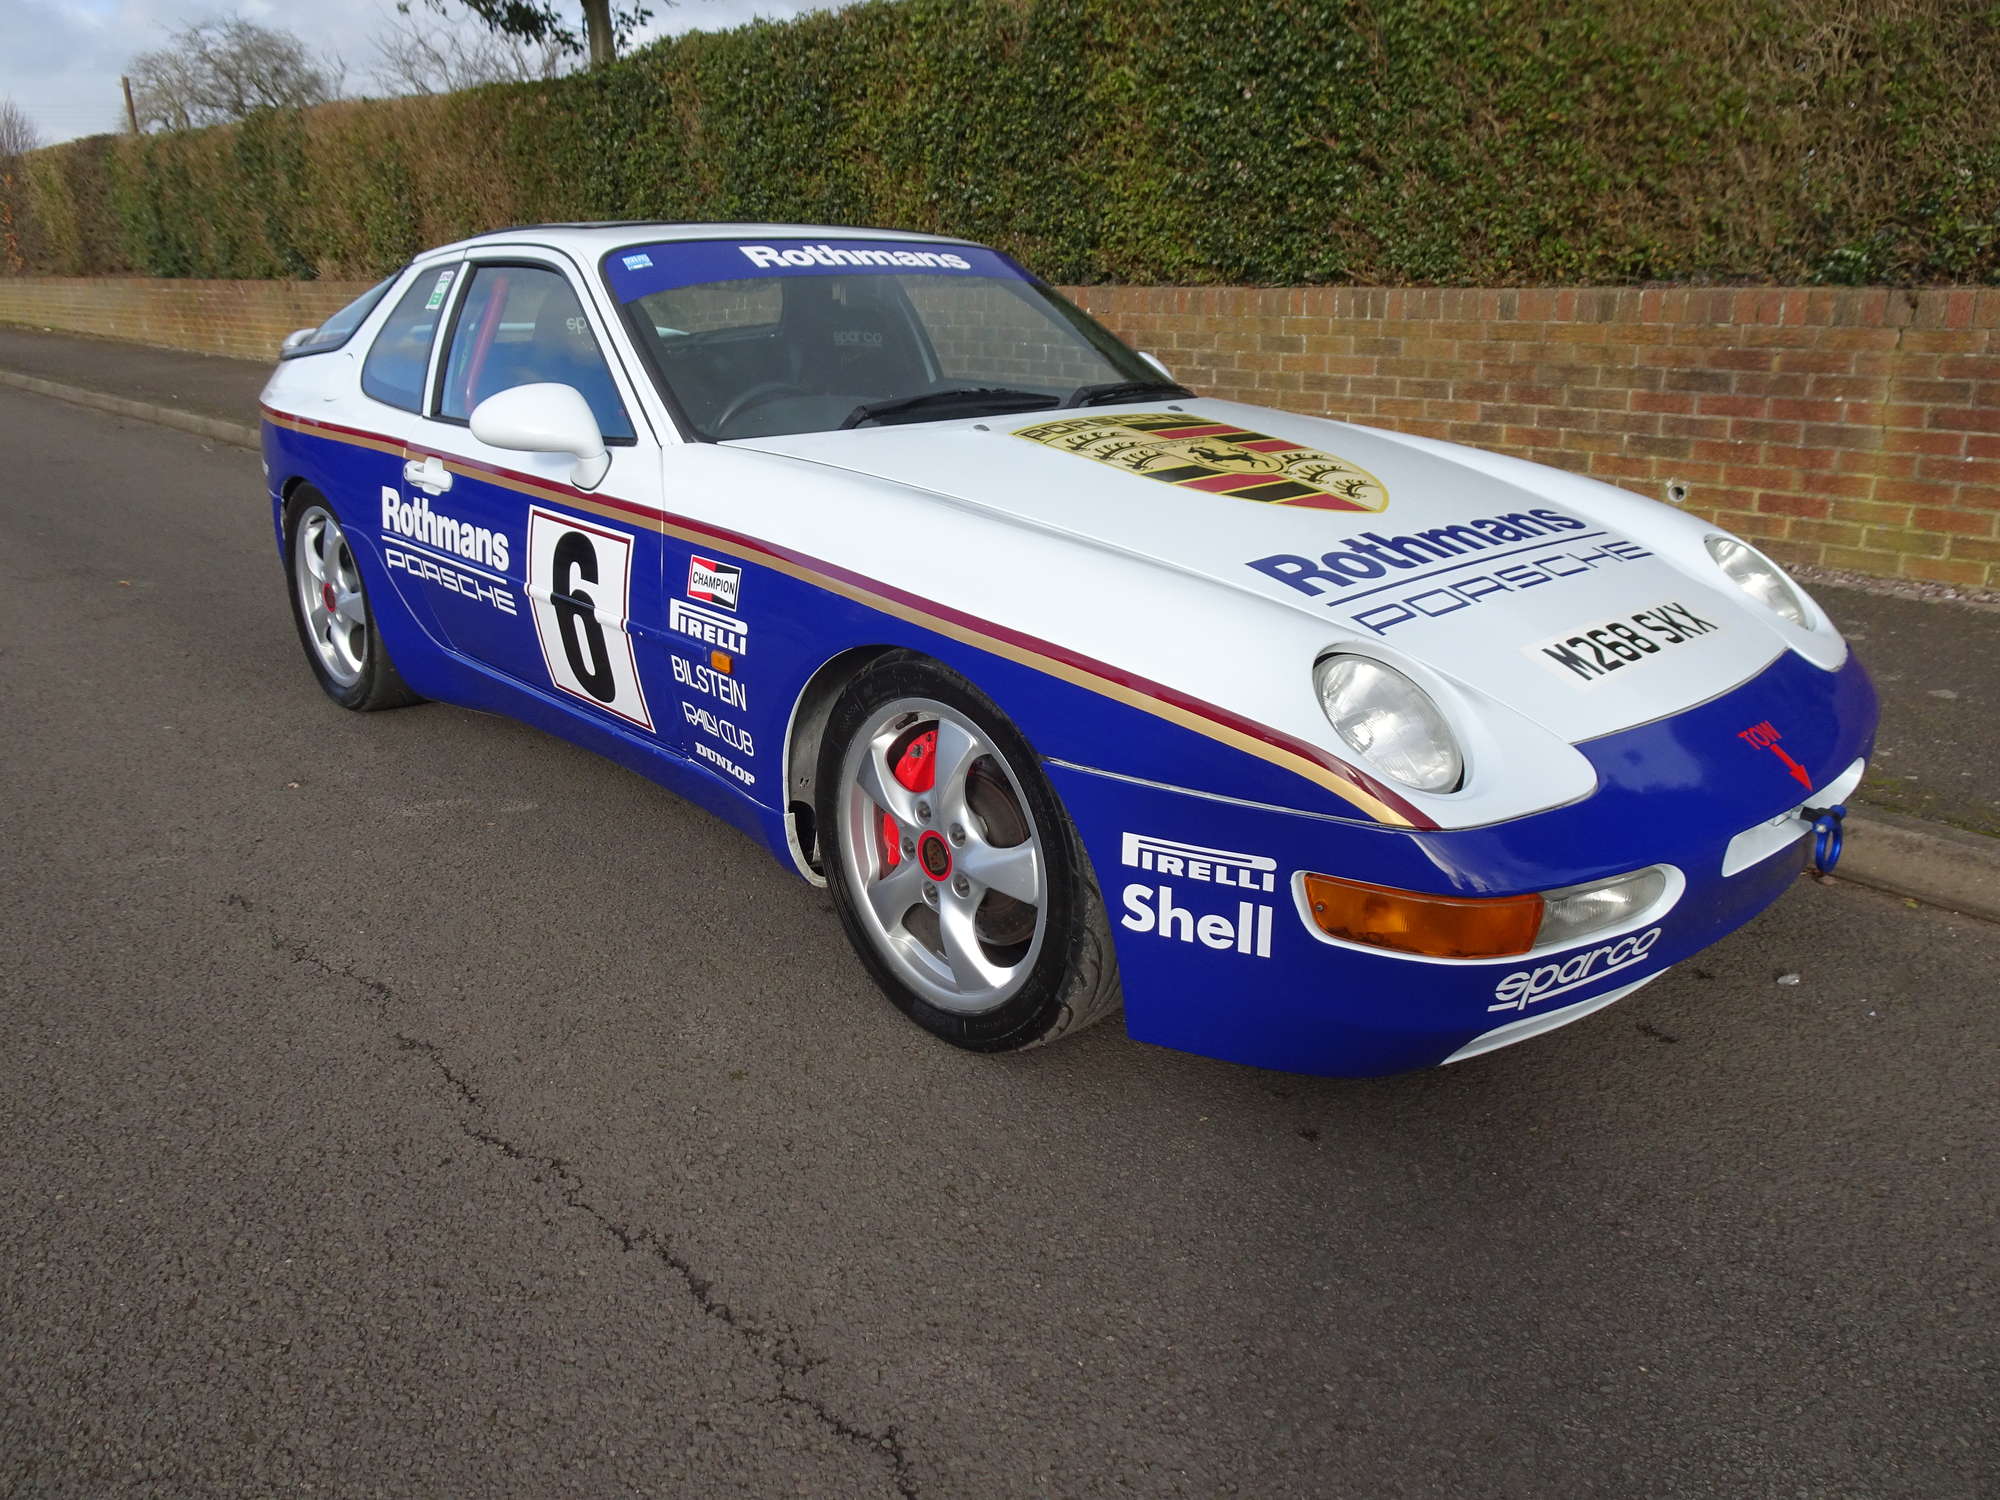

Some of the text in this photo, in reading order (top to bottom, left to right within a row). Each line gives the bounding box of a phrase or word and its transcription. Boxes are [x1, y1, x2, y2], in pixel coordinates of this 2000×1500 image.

[739, 244, 971, 270] Rothmans
[381, 485, 509, 571] Rothmans
[1246, 508, 1587, 597] Rothmans
[385, 548, 517, 615] PORSCHE
[692, 571, 736, 595] CHAMPION
[1350, 541, 1654, 636] PORSCHE
[552, 531, 616, 703] 6
[669, 598, 748, 655] PIRELLI
[1541, 602, 1720, 681] M268 SKX
[671, 654, 747, 712] BILSTEIN
[695, 742, 755, 786] DUNLOP
[720, 719, 755, 757] CLUB
[1737, 720, 1782, 750] TOW
[1121, 831, 1277, 893] PIRELLI
[1120, 883, 1273, 959] Shell
[1494, 927, 1662, 1010] sparco
